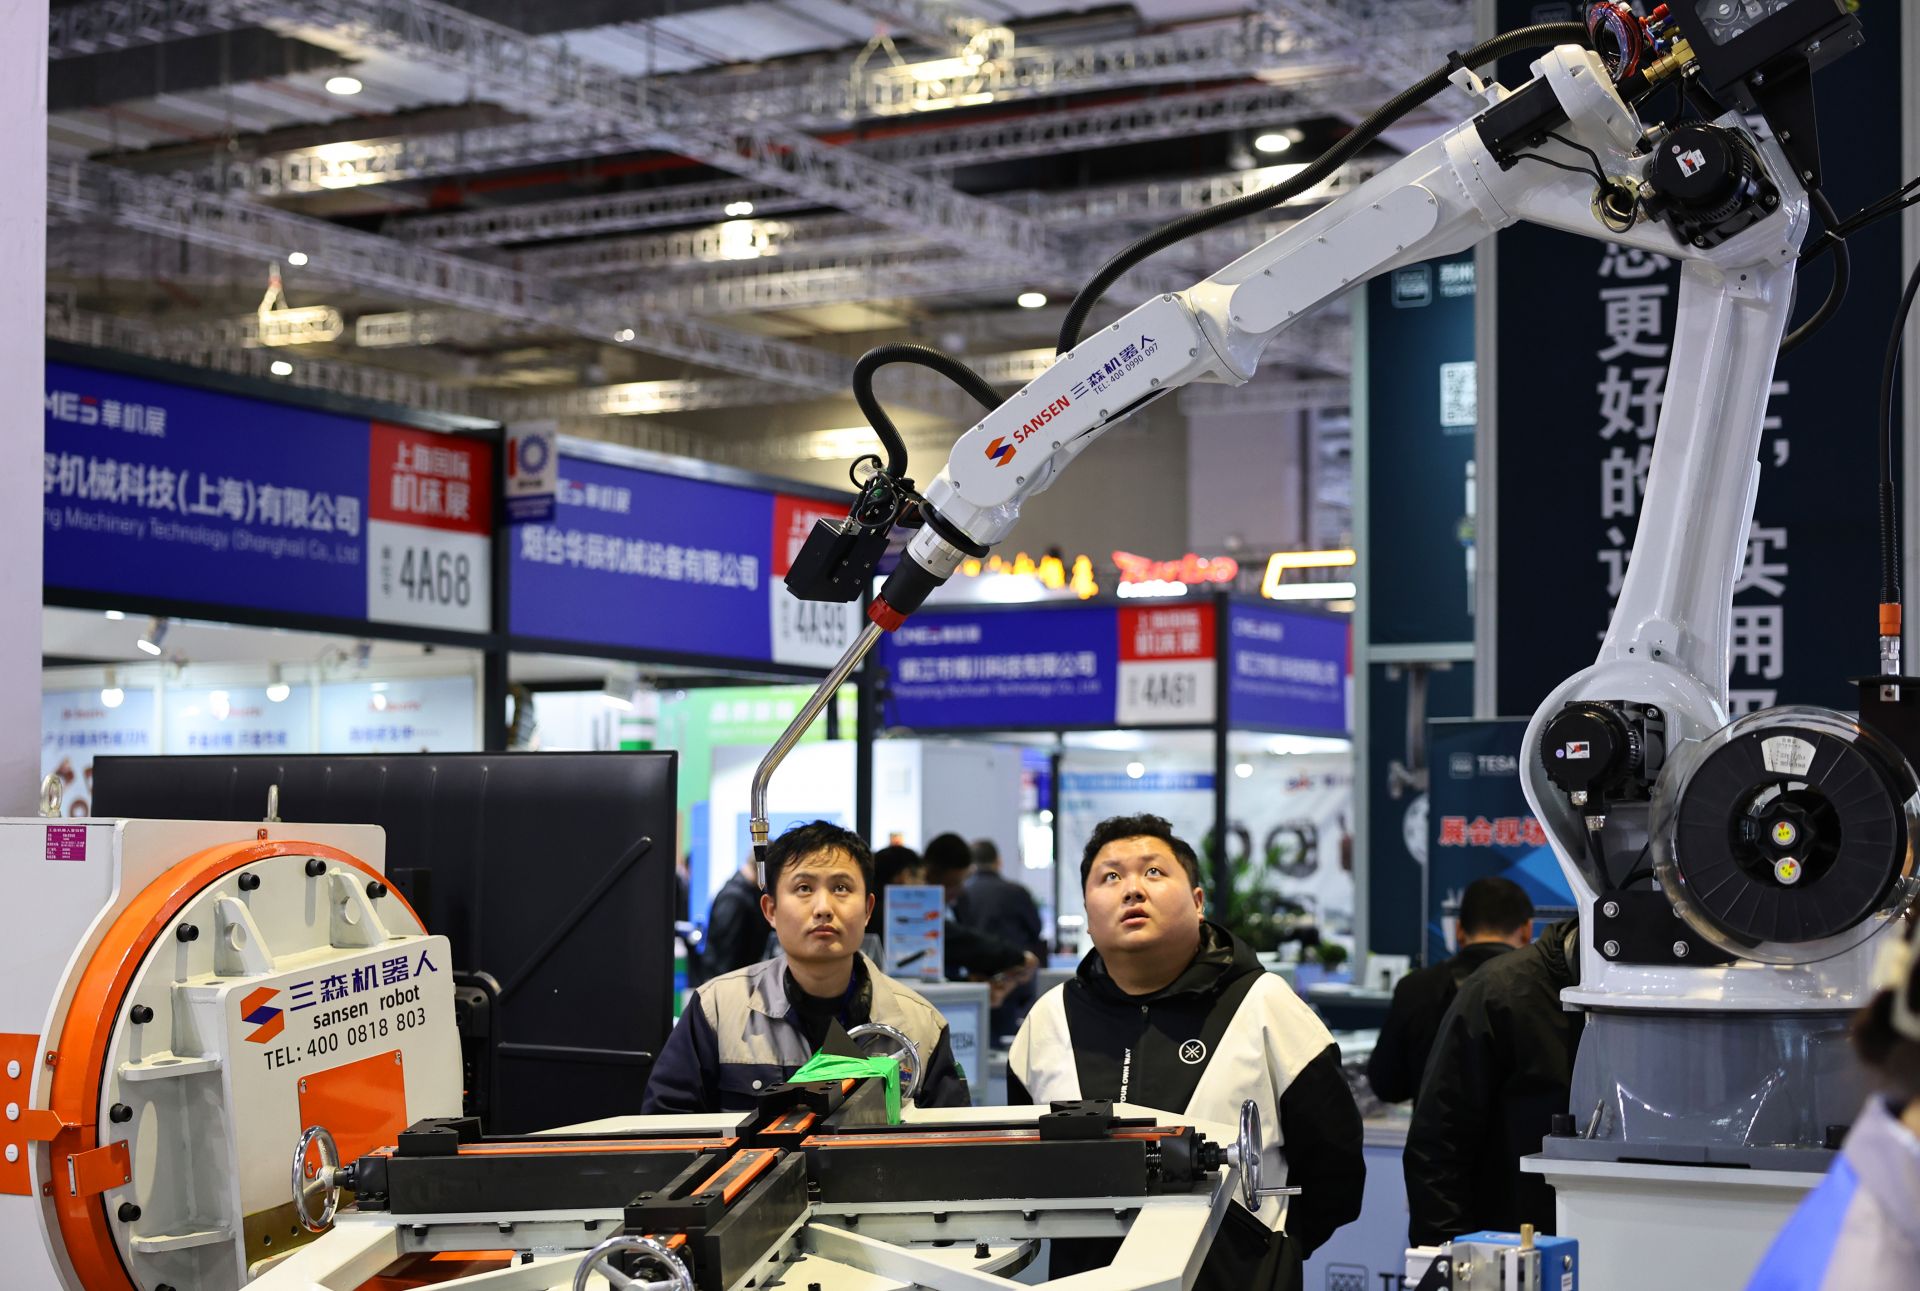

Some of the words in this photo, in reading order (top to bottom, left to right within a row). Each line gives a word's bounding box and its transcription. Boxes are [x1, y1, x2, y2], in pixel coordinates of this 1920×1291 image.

[1070, 334, 1156, 401] 三森机器人
[1126, 354, 1145, 372] 0990
[1144, 342, 1159, 357] 097
[1013, 394, 1071, 444] SANSEN
[399, 547, 471, 606] 4A68
[1439, 816, 1547, 848] 展会现场
[289, 950, 438, 1012] 三森机器人
[313, 1002, 368, 1029] sansen
[380, 985, 420, 1010] robot
[347, 1018, 388, 1045] 0818
[397, 1007, 426, 1031] 803
[1120, 1085, 1128, 1103] OUR
[1122, 1066, 1130, 1084] OWN
